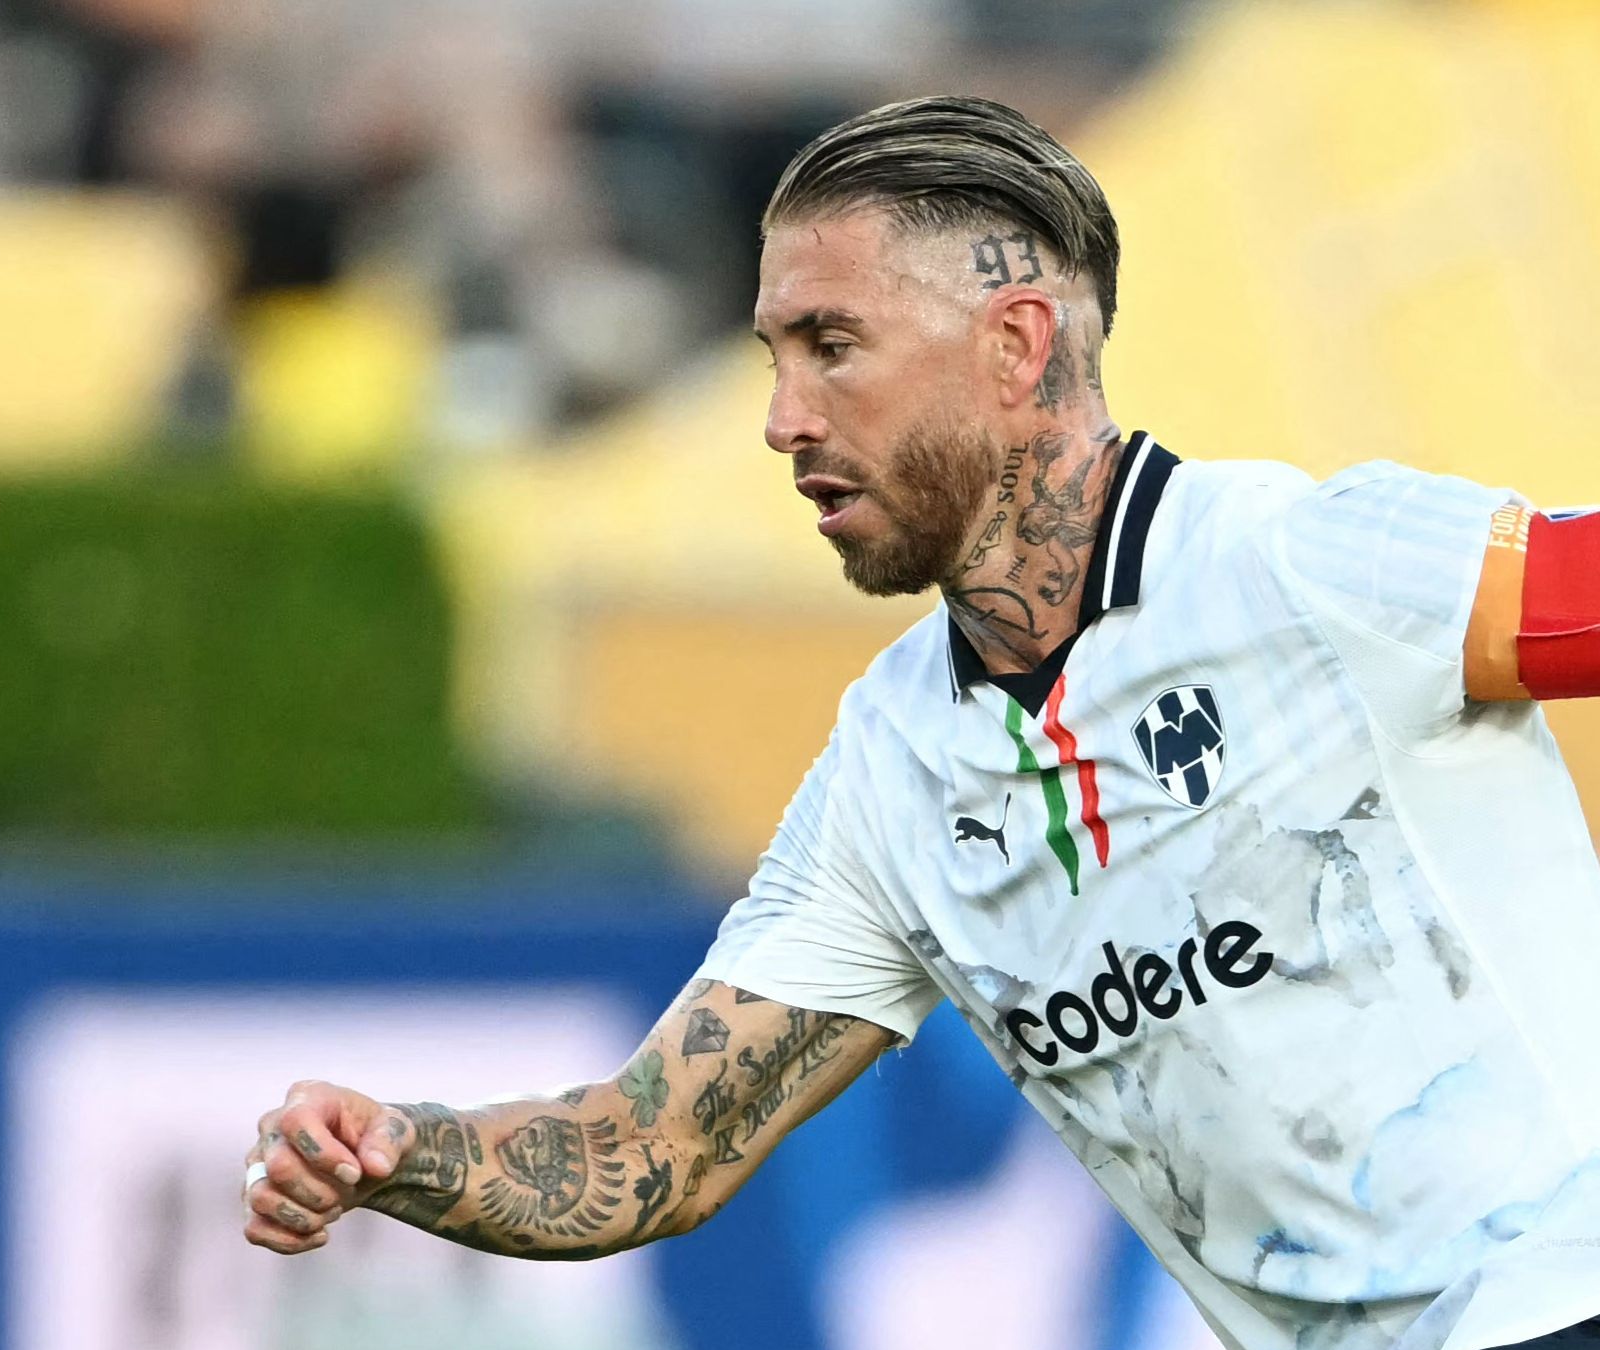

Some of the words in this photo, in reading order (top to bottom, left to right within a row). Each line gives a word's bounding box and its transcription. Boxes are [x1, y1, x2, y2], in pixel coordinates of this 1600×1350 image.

[969, 231, 1043, 290] 93
[997, 441, 1029, 504] SOUL
[1006, 920, 1274, 1067] codere
